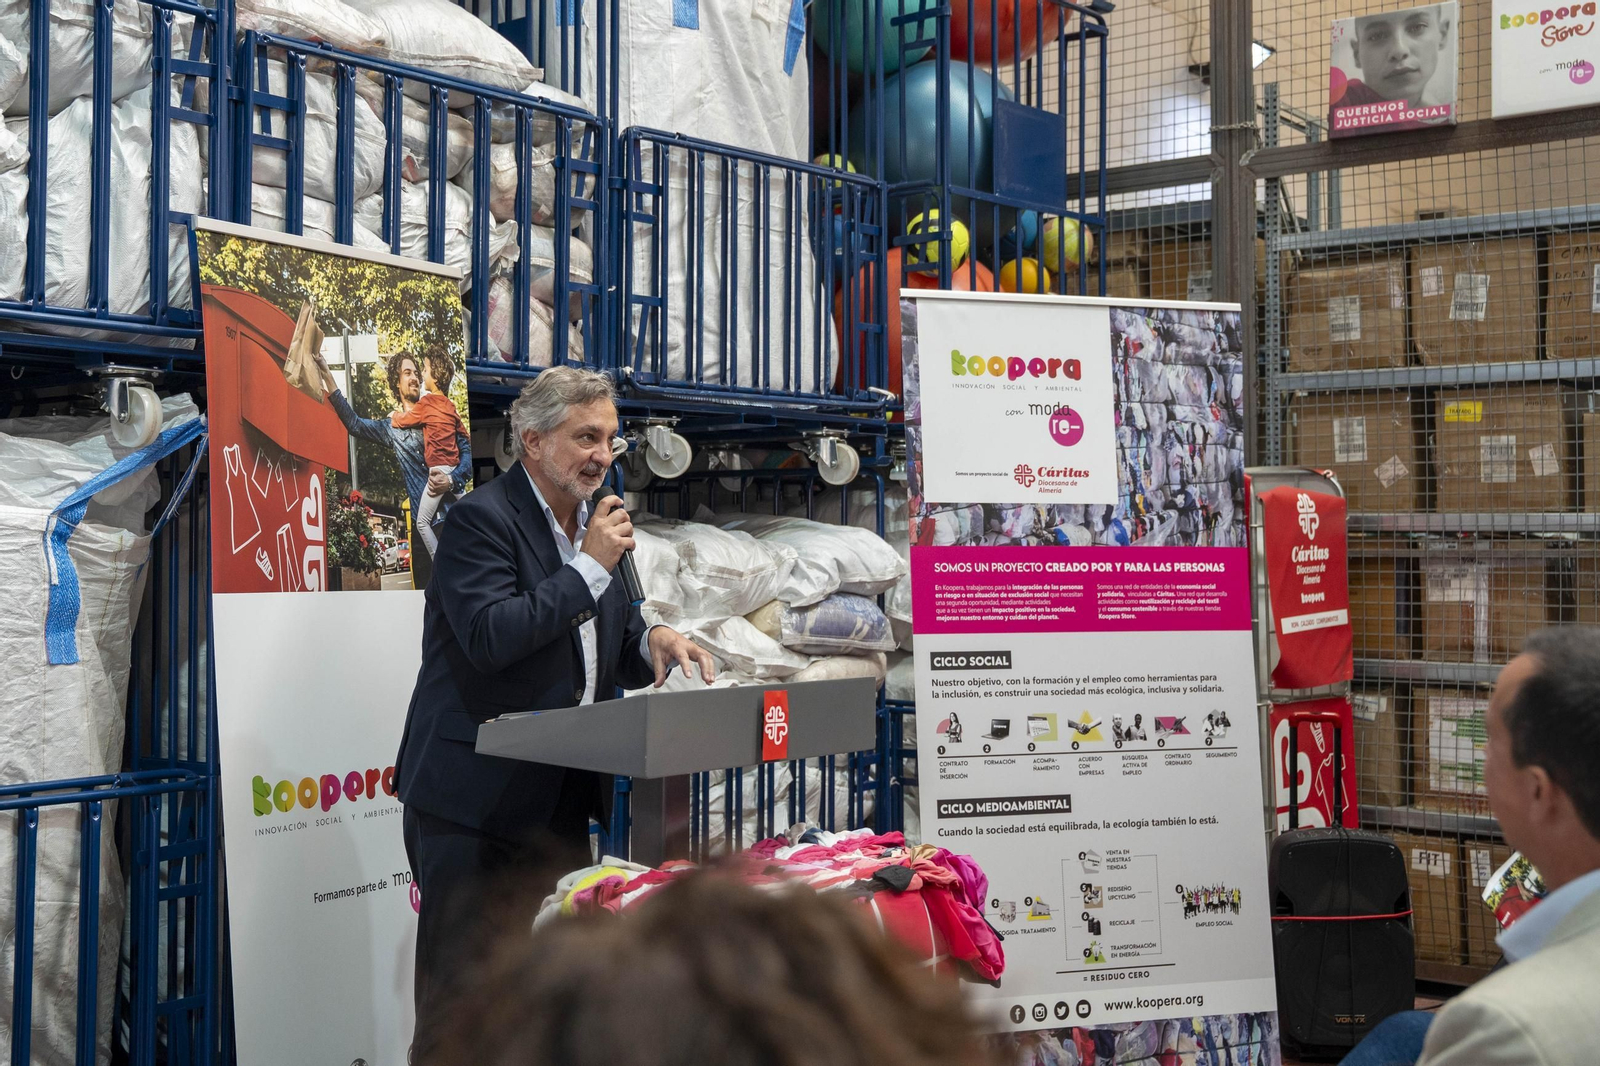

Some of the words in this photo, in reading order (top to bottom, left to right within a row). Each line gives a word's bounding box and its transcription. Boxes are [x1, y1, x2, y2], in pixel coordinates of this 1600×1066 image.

[1500, 2, 1596, 29] koopera
[1541, 22, 1594, 47] Store
[1556, 58, 1585, 70] moda
[1337, 102, 1404, 118] QUEREMOS
[1337, 114, 1393, 128] JUSTICIA
[1399, 107, 1446, 120] SOCIAL
[951, 349, 1082, 381] koopera
[1028, 402, 1072, 416] moda
[1038, 466, 1089, 478] Cáritas
[1291, 545, 1329, 563] Cáritas
[934, 562, 972, 572] SOMOS
[974, 563, 988, 572] UN
[991, 562, 1043, 572] PROYECTO
[1045, 562, 1089, 572] CREADO
[1091, 562, 1112, 572] POR
[1114, 562, 1121, 571] Y
[1124, 562, 1151, 571] PARA
[1153, 562, 1172, 572] LAS
[1174, 562, 1224, 572] PERSONAS
[1297, 566, 1319, 574] Diocesana
[1320, 564, 1326, 572] de
[1303, 575, 1320, 584] Almería
[1012, 584, 1042, 592] integración
[933, 656, 966, 666] CICLO
[969, 656, 1009, 666] SOCIAL
[967, 677, 1003, 688] objetivo,
[1032, 676, 1073, 684] formación
[1092, 675, 1121, 685] empleo
[1147, 674, 1198, 682] herramientas
[1200, 675, 1217, 683] para
[932, 690, 939, 698] la
[942, 689, 981, 698] inclusión,
[994, 688, 1031, 697] construir
[1050, 687, 1085, 695] sociedad
[1106, 686, 1145, 696] ecológica,
[1189, 684, 1224, 692] solidaria.
[252, 766, 398, 816] koopera
[940, 803, 973, 814] CICLO
[976, 799, 1070, 812] MEDIOAMBIENTAL
[254, 821, 307, 836] INNOVACIÓN
[316, 816, 342, 826] SOCIAL
[364, 806, 402, 818] AMBIENTAL
[938, 826, 973, 836] Cuando
[976, 826, 983, 834] la
[986, 824, 1025, 834] sociedad
[1028, 823, 1046, 832] está
[1048, 820, 1100, 833] equilibrada,
[1102, 820, 1110, 828] la
[1113, 818, 1149, 829] ecología
[1151, 816, 1186, 826] también
[1188, 816, 1197, 825] lo
[1199, 815, 1218, 824] está.
[1420, 852, 1439, 866] FIT
[314, 887, 355, 903] Formamos
[356, 882, 376, 897] parte
[378, 879, 387, 889] de
[392, 871, 411, 886] mo
[1110, 942, 1156, 950] TRANSFORMACIÓN
[1090, 972, 1125, 981] RESIDUO
[1128, 970, 1149, 979] CERO
[1104, 995, 1203, 1010] www.koopera.org
